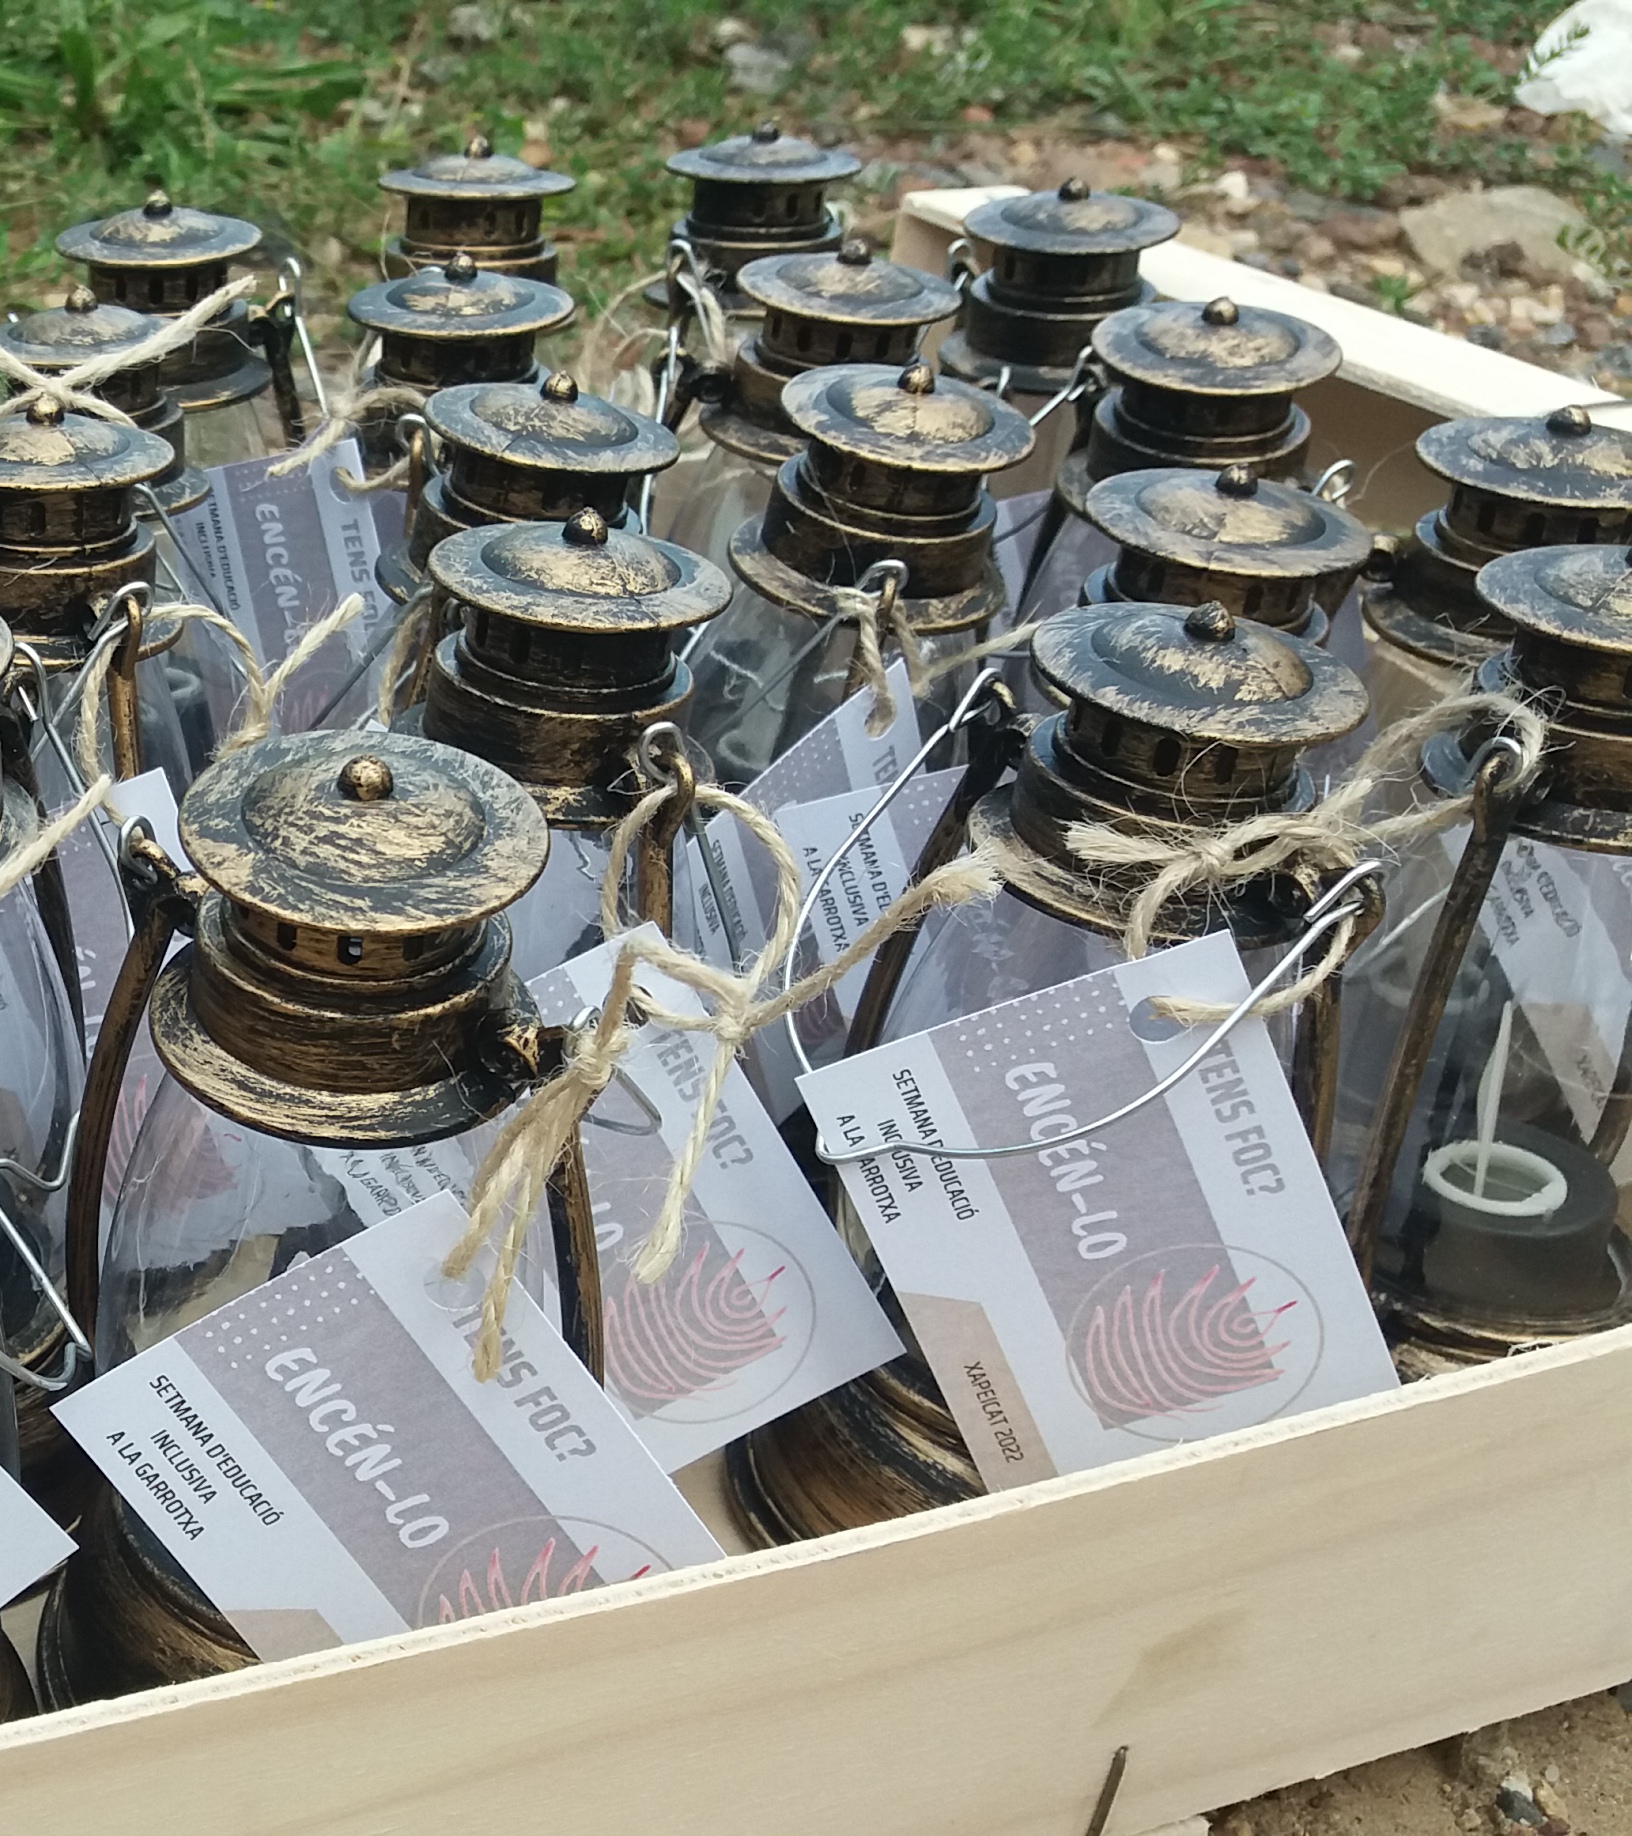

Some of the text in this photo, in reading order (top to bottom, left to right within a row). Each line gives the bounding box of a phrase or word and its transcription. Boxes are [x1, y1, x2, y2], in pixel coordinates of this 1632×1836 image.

[341, 518, 370, 584] TENS
[803, 847, 818, 857] A
[892, 1068, 938, 1141] SETMANA
[1198, 1038, 1256, 1126] TENS
[836, 1114, 902, 1224] A LA ARROTXA
[877, 1119, 924, 1193] INCUSIVA
[1005, 1062, 1127, 1260] ENCÉN-LO
[1225, 1124, 1286, 1198] FOC?
[149, 1374, 285, 1526] SETMANA D'EDUCACIÓ
[264, 1347, 449, 1550] ENCÉN-LO
[513, 1385, 597, 1463] FOC?
[963, 1361, 1024, 1463] XAPEICAT 2022
[106, 1431, 205, 1541] A LA GARROTXA
[150, 1429, 217, 1505] INCLUSIVA
